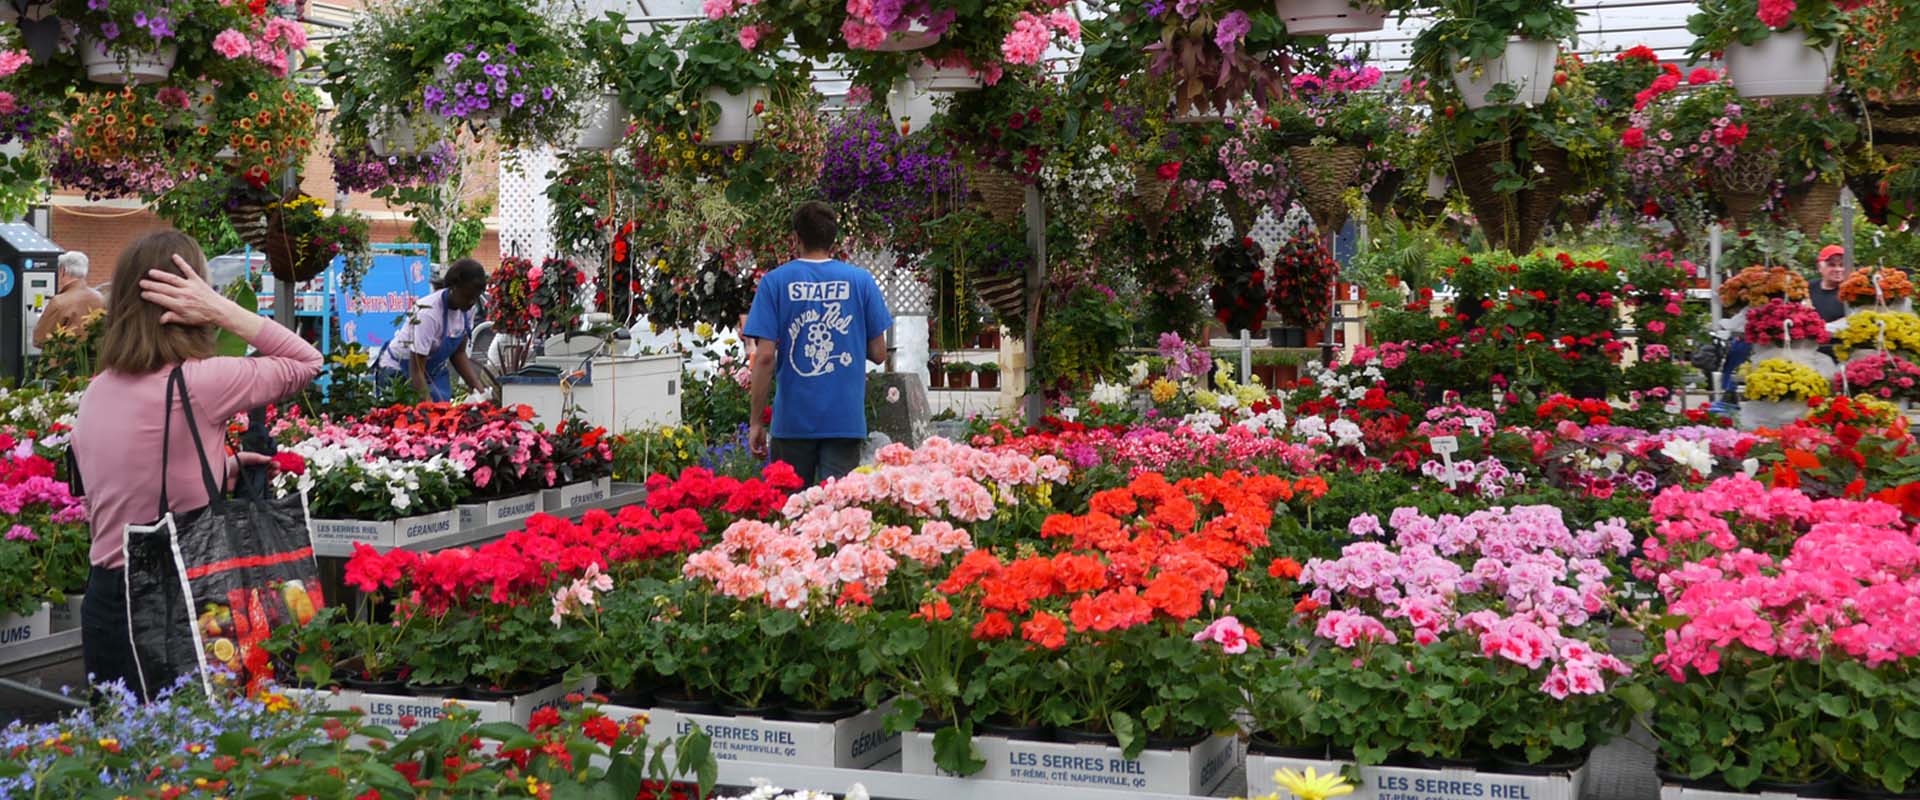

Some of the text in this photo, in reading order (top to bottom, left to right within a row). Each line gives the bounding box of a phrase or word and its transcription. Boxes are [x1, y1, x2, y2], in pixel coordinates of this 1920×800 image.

[791, 283, 847, 299] STAFF
[821, 302, 853, 335] Riel
[497, 501, 536, 519] GÉRANIUMS
[317, 524, 378, 535] LES SERRES RIEL
[406, 519, 450, 538] GÉRANIUMS
[370, 702, 441, 719] LES SERRE
[676, 722, 795, 745] LE SERRES RIEL
[784, 747, 796, 757] QC
[1010, 752, 1145, 775] LES SERRES RIEL
[1071, 774, 1131, 787] NAPIERVILLE,
[1133, 778, 1146, 788] QC
[1378, 775, 1530, 800] LES SERRES RIEL
